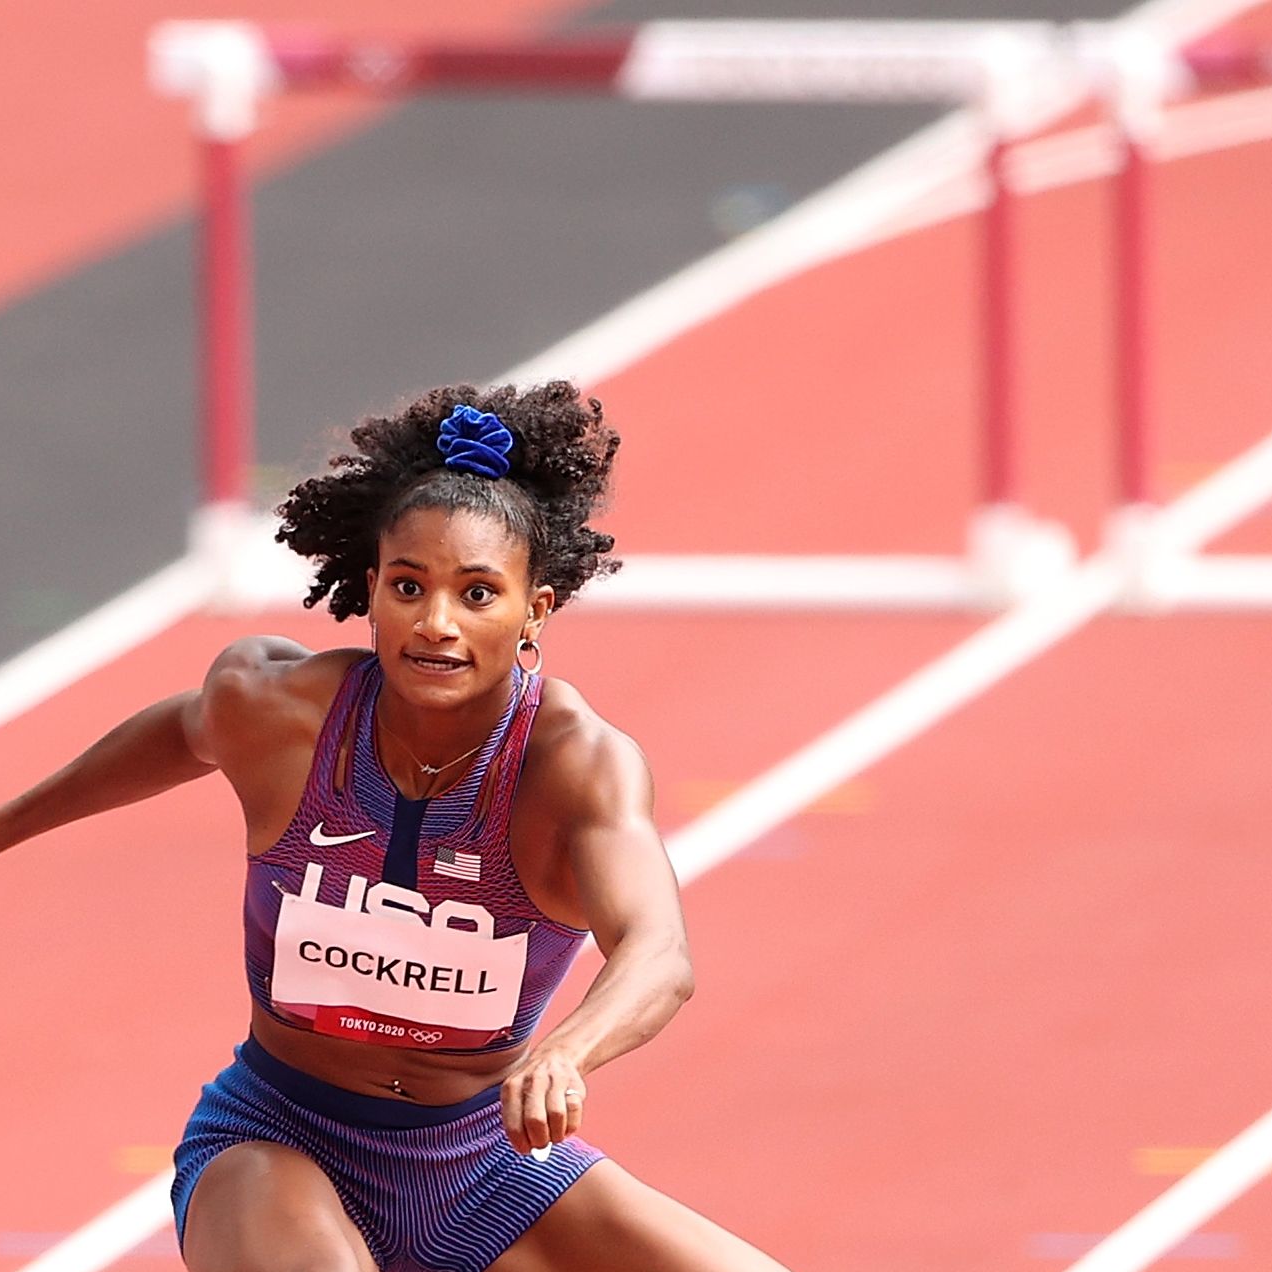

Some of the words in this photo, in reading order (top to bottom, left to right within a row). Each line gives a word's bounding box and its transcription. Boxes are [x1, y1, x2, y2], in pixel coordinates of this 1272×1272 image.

[298, 940, 498, 995] COCKRELL
[339, 1016, 377, 1031] TOKYO
[377, 1023, 405, 1037] 2020
